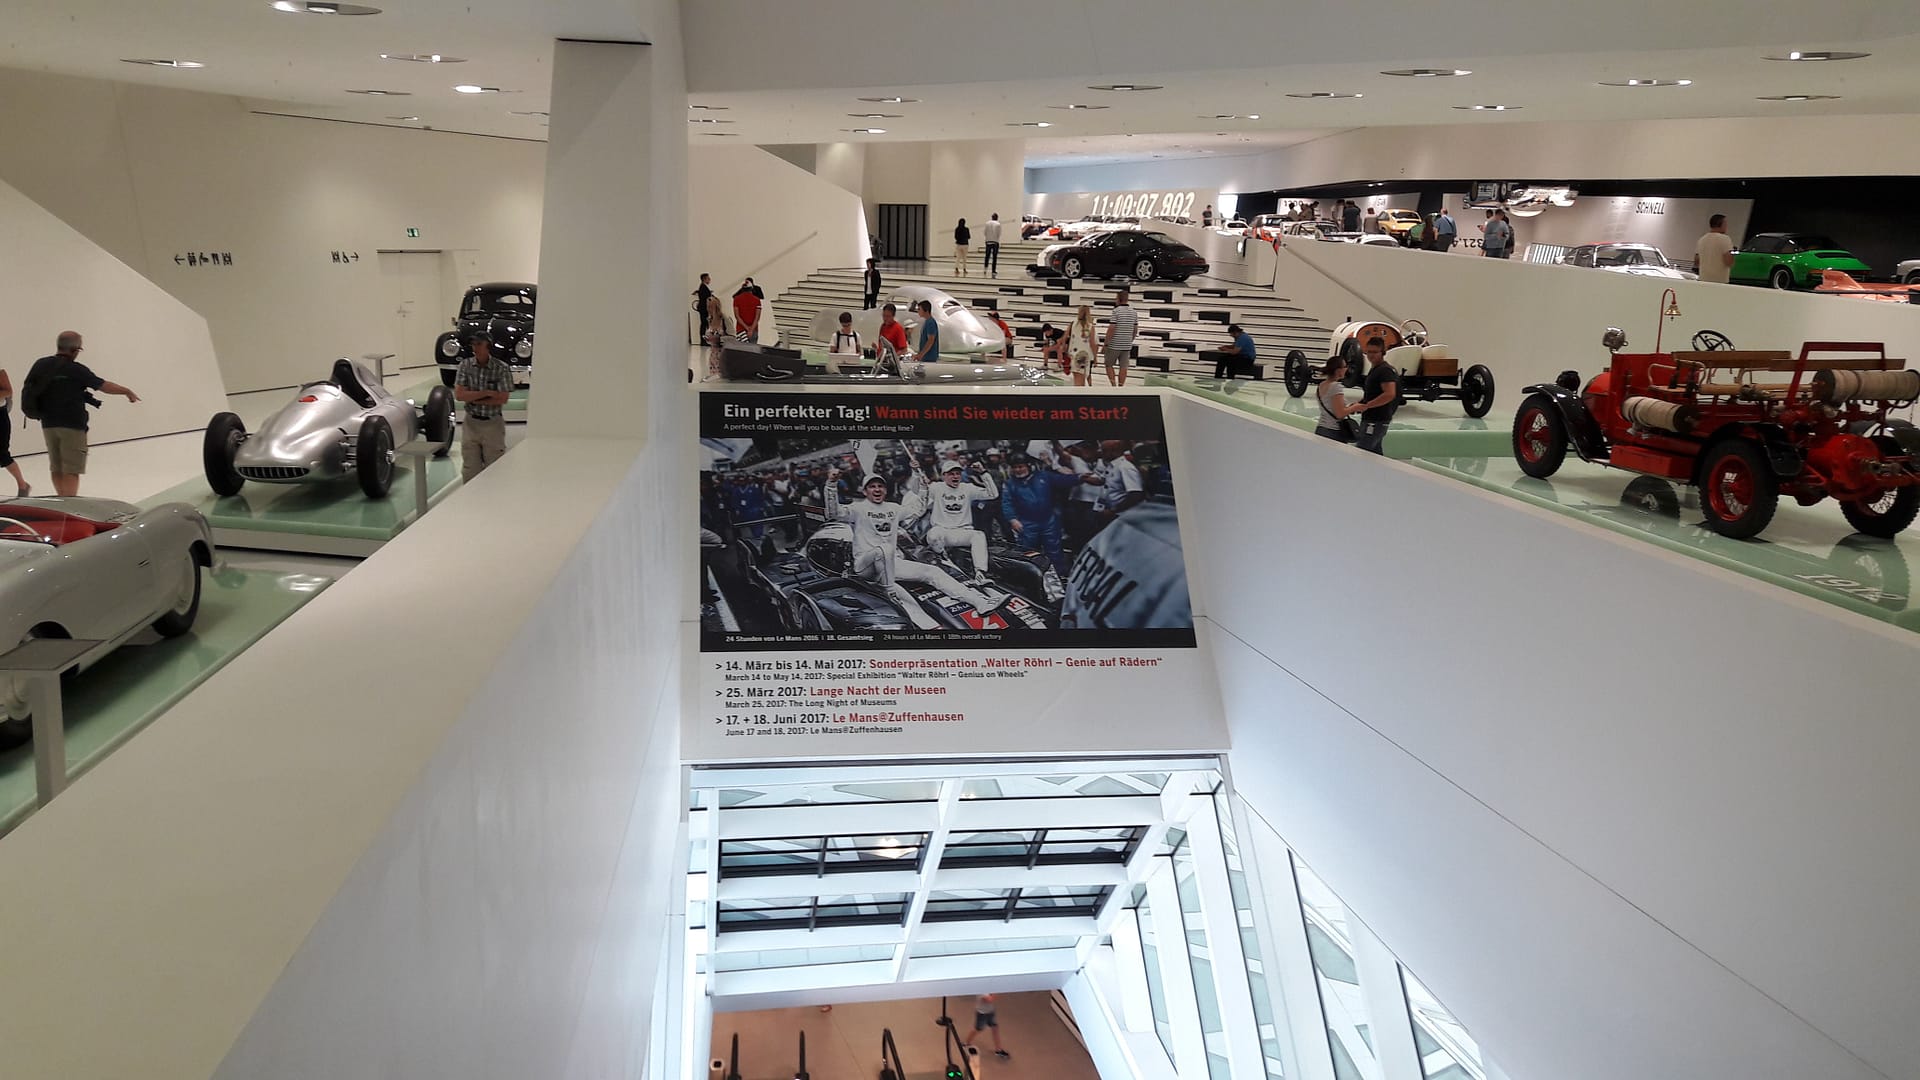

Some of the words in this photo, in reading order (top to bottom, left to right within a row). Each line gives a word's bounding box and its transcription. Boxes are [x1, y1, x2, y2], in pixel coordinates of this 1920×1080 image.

[1636, 201, 1665, 215] SCHNELL
[724, 404, 750, 417] Ein
[755, 405, 832, 420] perfekter
[836, 405, 870, 422] Tag!
[875, 406, 918, 419] Wann
[924, 407, 957, 419] sind
[963, 406, 987, 420] Sie
[992, 407, 1044, 420] wieder
[1050, 410, 1073, 420] am
[1079, 407, 1128, 420] Start?
[730, 424, 754, 432] perfect
[756, 424, 771, 432] day!
[870, 425, 896, 433] starting
[898, 424, 914, 432] line?
[837, 634, 874, 642] Gesamtsieg
[725, 661, 742, 671] 14.
[745, 660, 773, 670] März
[776, 660, 793, 670] bis
[796, 660, 812, 670] 14.
[815, 660, 835, 670] Mai
[837, 659, 867, 669] 2017:
[869, 658, 978, 671] Sonderpräsentation
[1024, 657, 1053, 667] Röhrl
[1066, 657, 1096, 667] Genie
[1099, 657, 1116, 667] auf
[773, 673, 789, 682] May
[804, 673, 824, 681] 2017:
[826, 672, 855, 681] Special
[857, 671, 896, 680] Exhibition
[928, 670, 948, 679] Röhrl
[958, 670, 984, 678] Genius
[726, 687, 743, 697] 25.
[746, 686, 774, 697] März
[777, 686, 807, 697] 2017:
[810, 685, 844, 698] Lange
[847, 685, 879, 696] Nacht
[883, 685, 900, 696] der
[904, 684, 946, 695] Museen
[725, 701, 749, 709] March
[805, 700, 824, 709] Long
[826, 699, 848, 709] Night
[860, 698, 897, 706] Museums
[726, 715, 740, 725] 17.
[754, 714, 769, 725] 18.
[772, 713, 797, 724] Juni
[800, 713, 829, 723] 2017:
[833, 713, 846, 723] Le
[849, 711, 964, 724] Mans@Zuffenhausen
[787, 727, 808, 735] 2017:
[821, 725, 903, 734] Mans@Zuffenhausen
